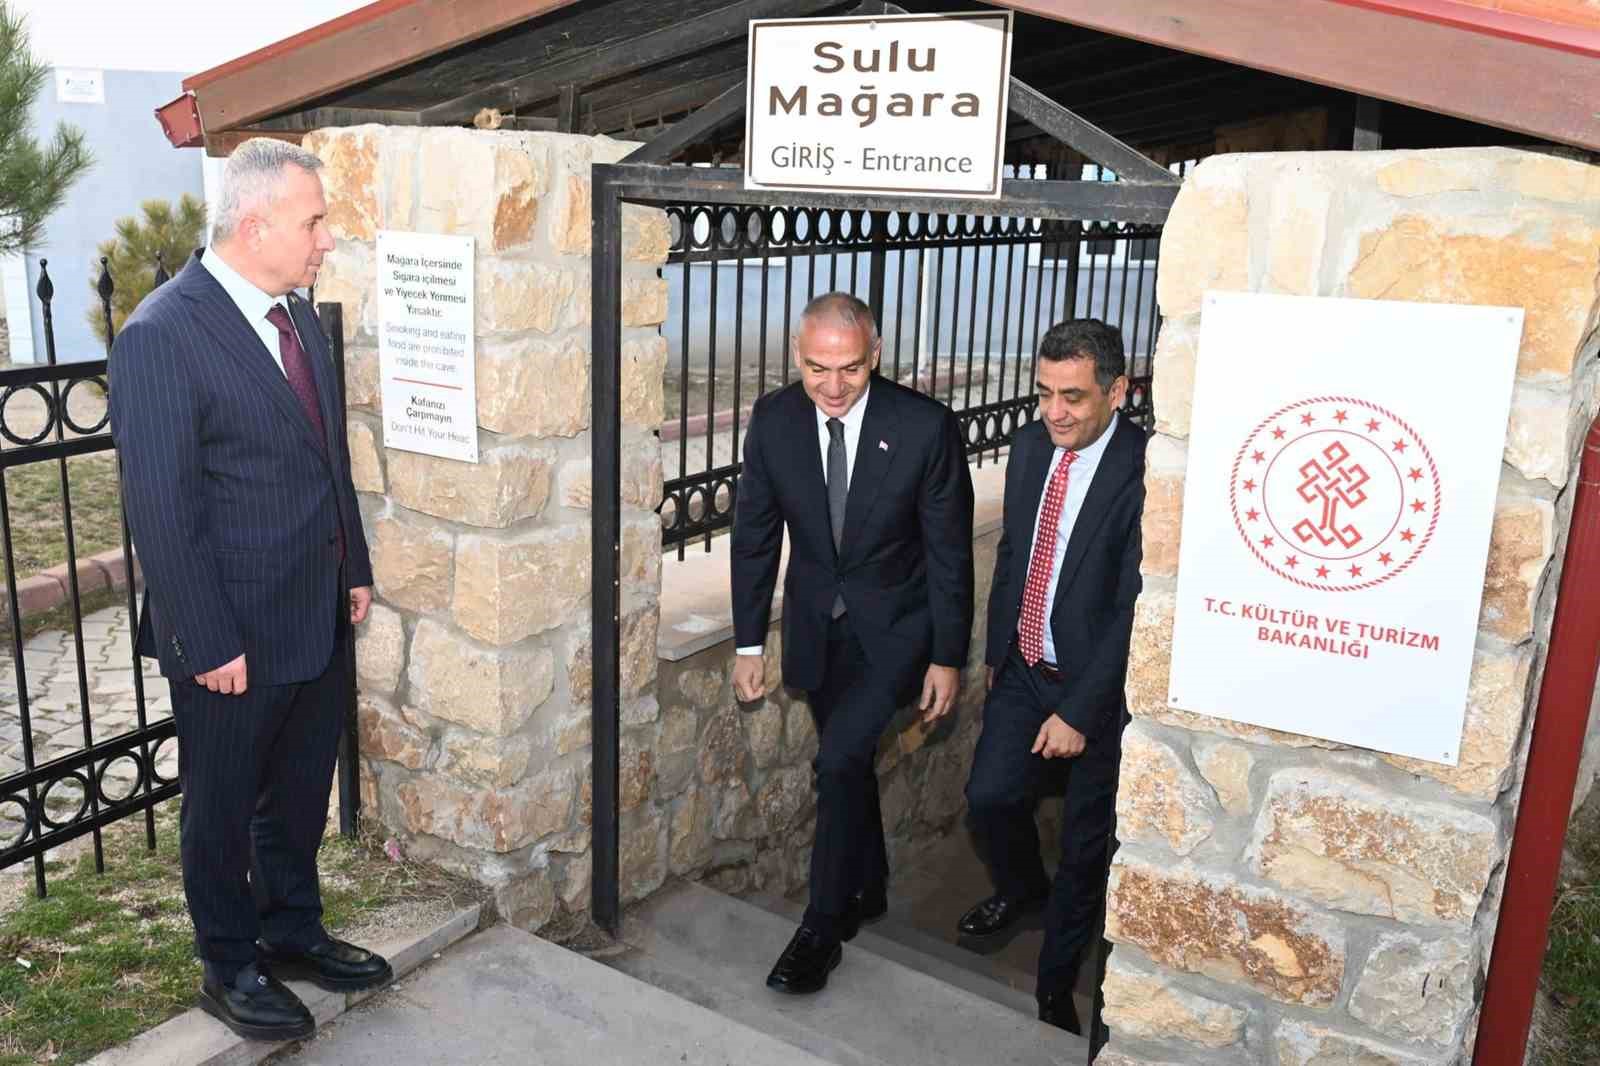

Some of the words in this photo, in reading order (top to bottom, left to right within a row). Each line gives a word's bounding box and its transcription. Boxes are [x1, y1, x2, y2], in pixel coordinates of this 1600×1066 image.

[813, 40, 936, 73] Sulu
[769, 84, 980, 128] Mağara
[771, 142, 835, 176] GİRİŞ
[862, 147, 972, 173] Entrance
[384, 287, 394, 297] ve
[1204, 597, 1236, 617] T.C.
[1241, 604, 1319, 630] KÜLTÜR
[1325, 617, 1350, 636] VE
[1357, 623, 1440, 651] TURİZM
[1257, 626, 1369, 659] BAKANLIĞI
